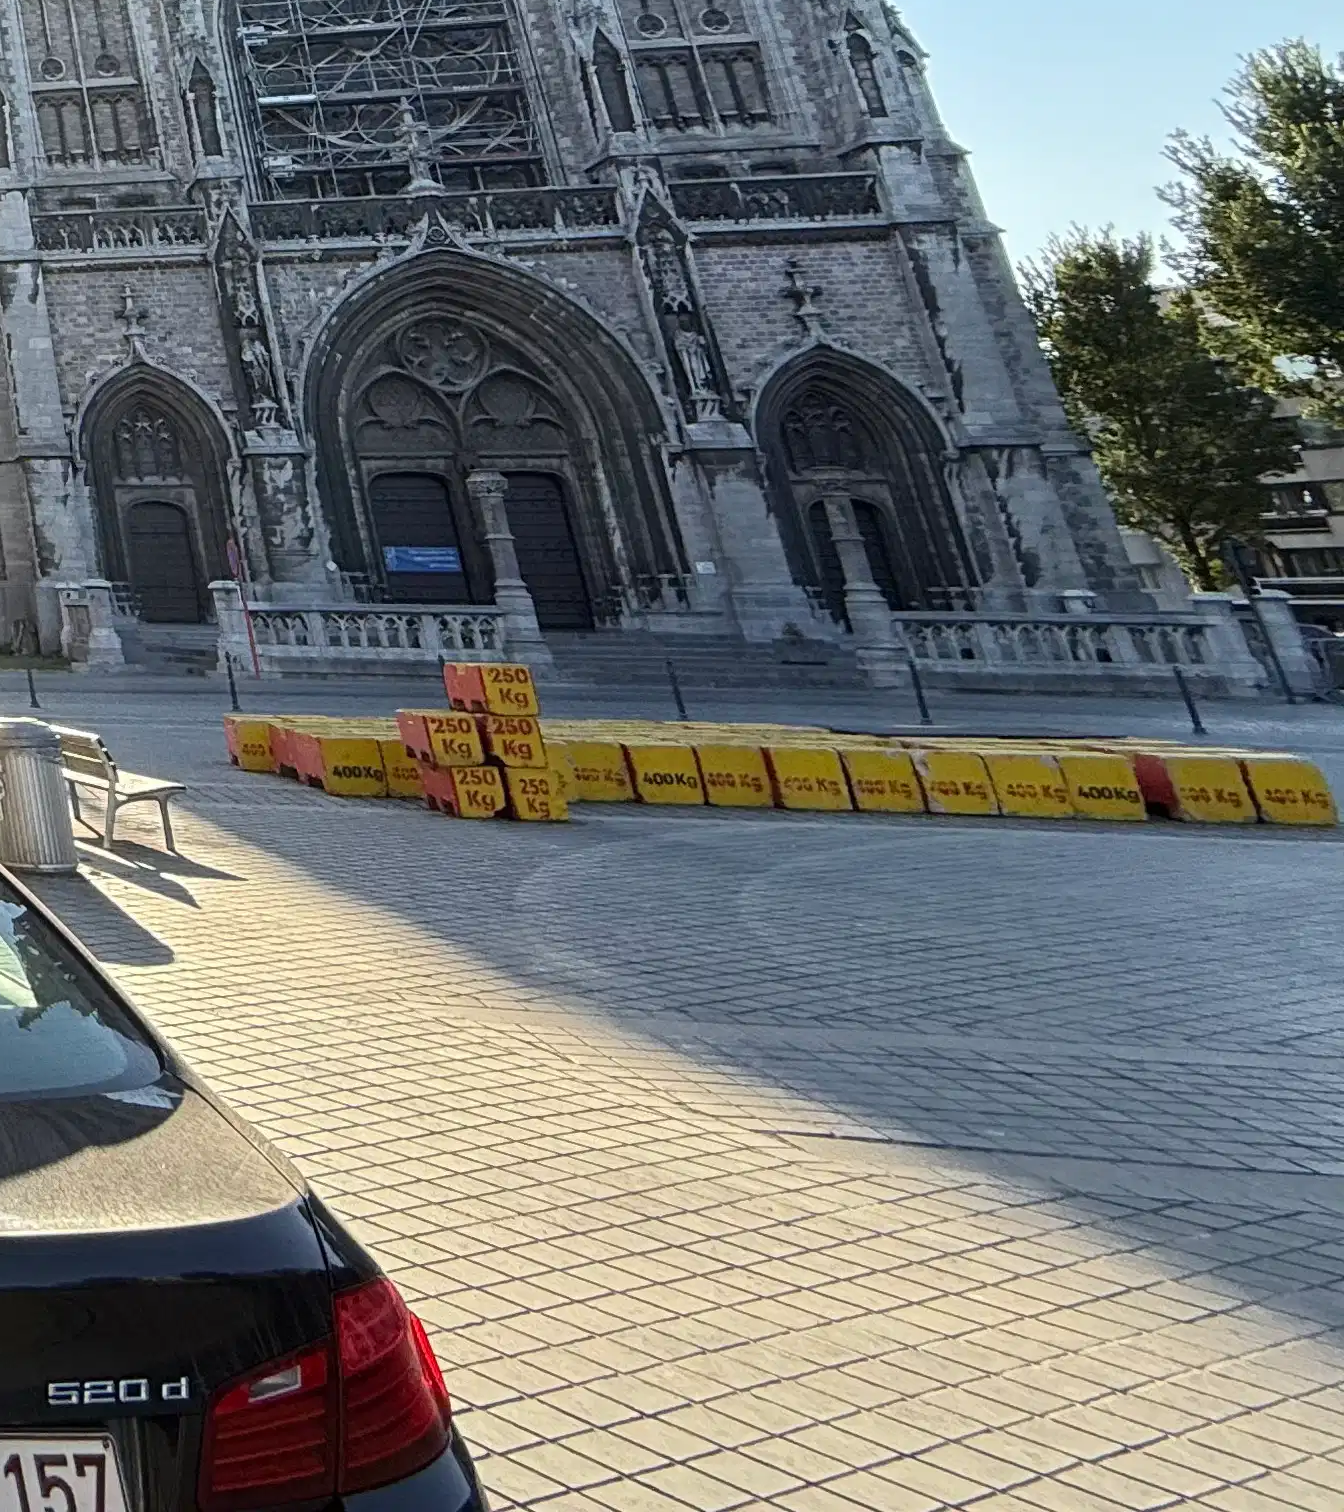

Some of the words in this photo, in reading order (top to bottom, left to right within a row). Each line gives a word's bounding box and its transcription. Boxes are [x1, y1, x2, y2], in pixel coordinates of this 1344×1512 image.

[488, 668, 529, 684] 250
[499, 688, 529, 709] Kg
[430, 718, 472, 734] 250
[493, 719, 533, 735] 250
[441, 739, 473, 759] Kg
[502, 740, 533, 760] Kg
[457, 769, 496, 785] 250
[519, 779, 550, 796] 250
[466, 790, 496, 812] Kg
[526, 798, 551, 820] Kg
